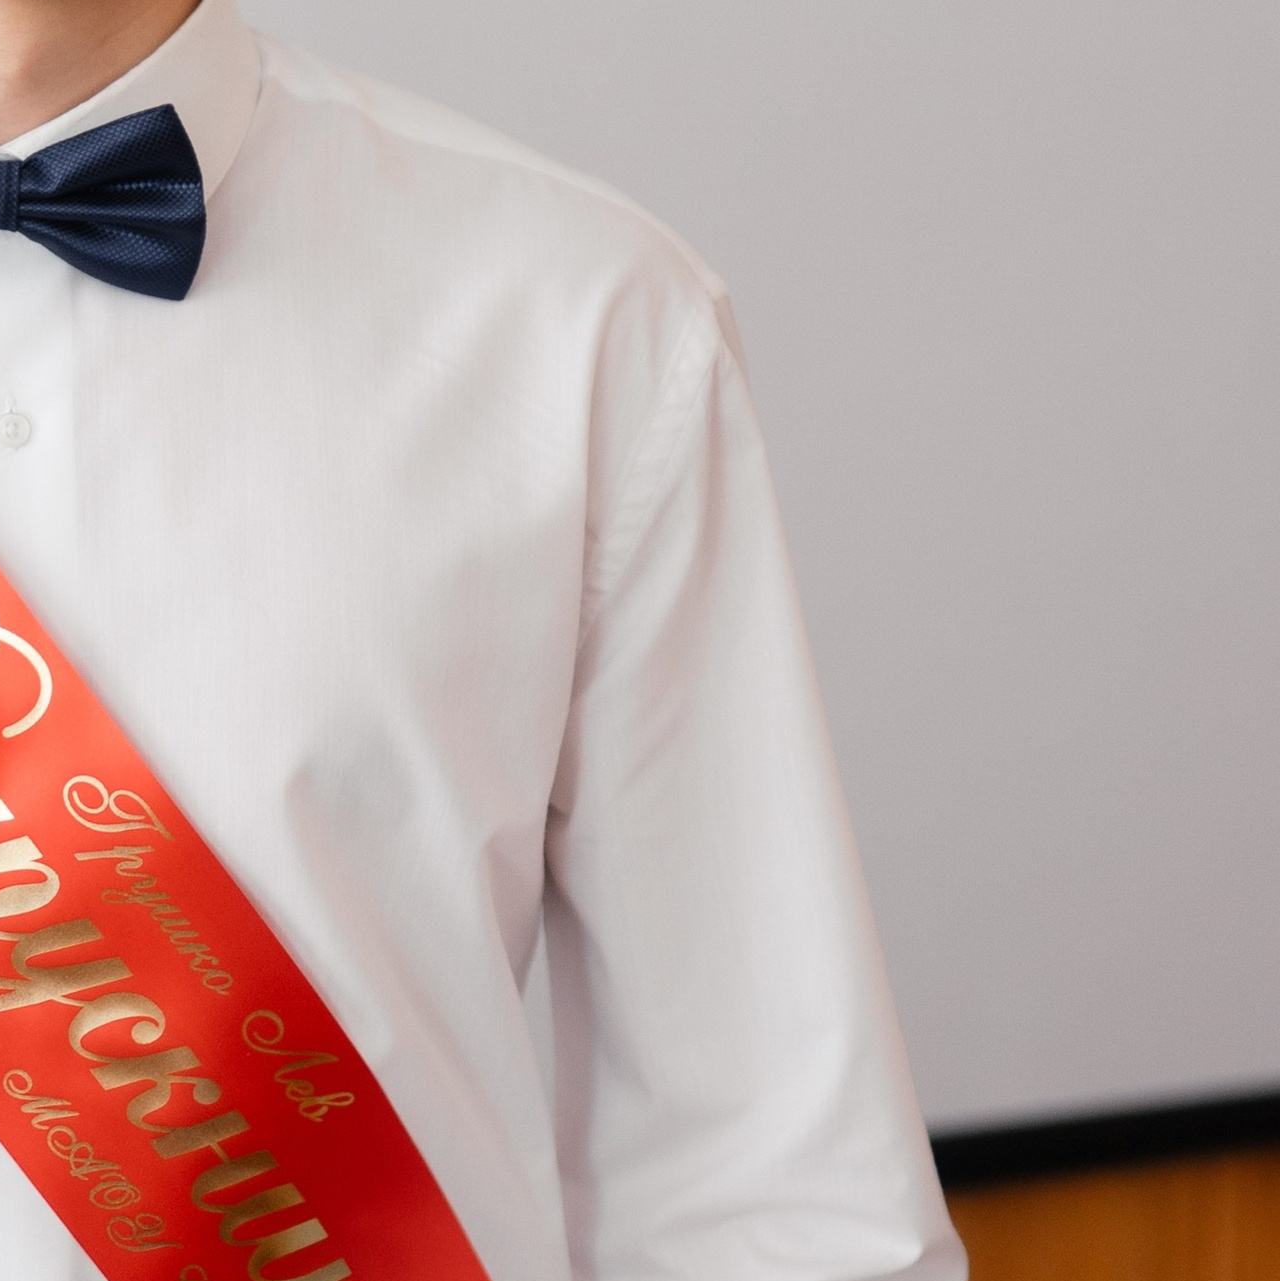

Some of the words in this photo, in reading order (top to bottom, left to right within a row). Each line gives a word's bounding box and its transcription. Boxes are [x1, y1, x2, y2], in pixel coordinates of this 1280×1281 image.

[62, 775, 233, 995] Грушко
[241, 1009, 355, 1122] Лев
[2, 1069, 184, 1253] МАОУ
